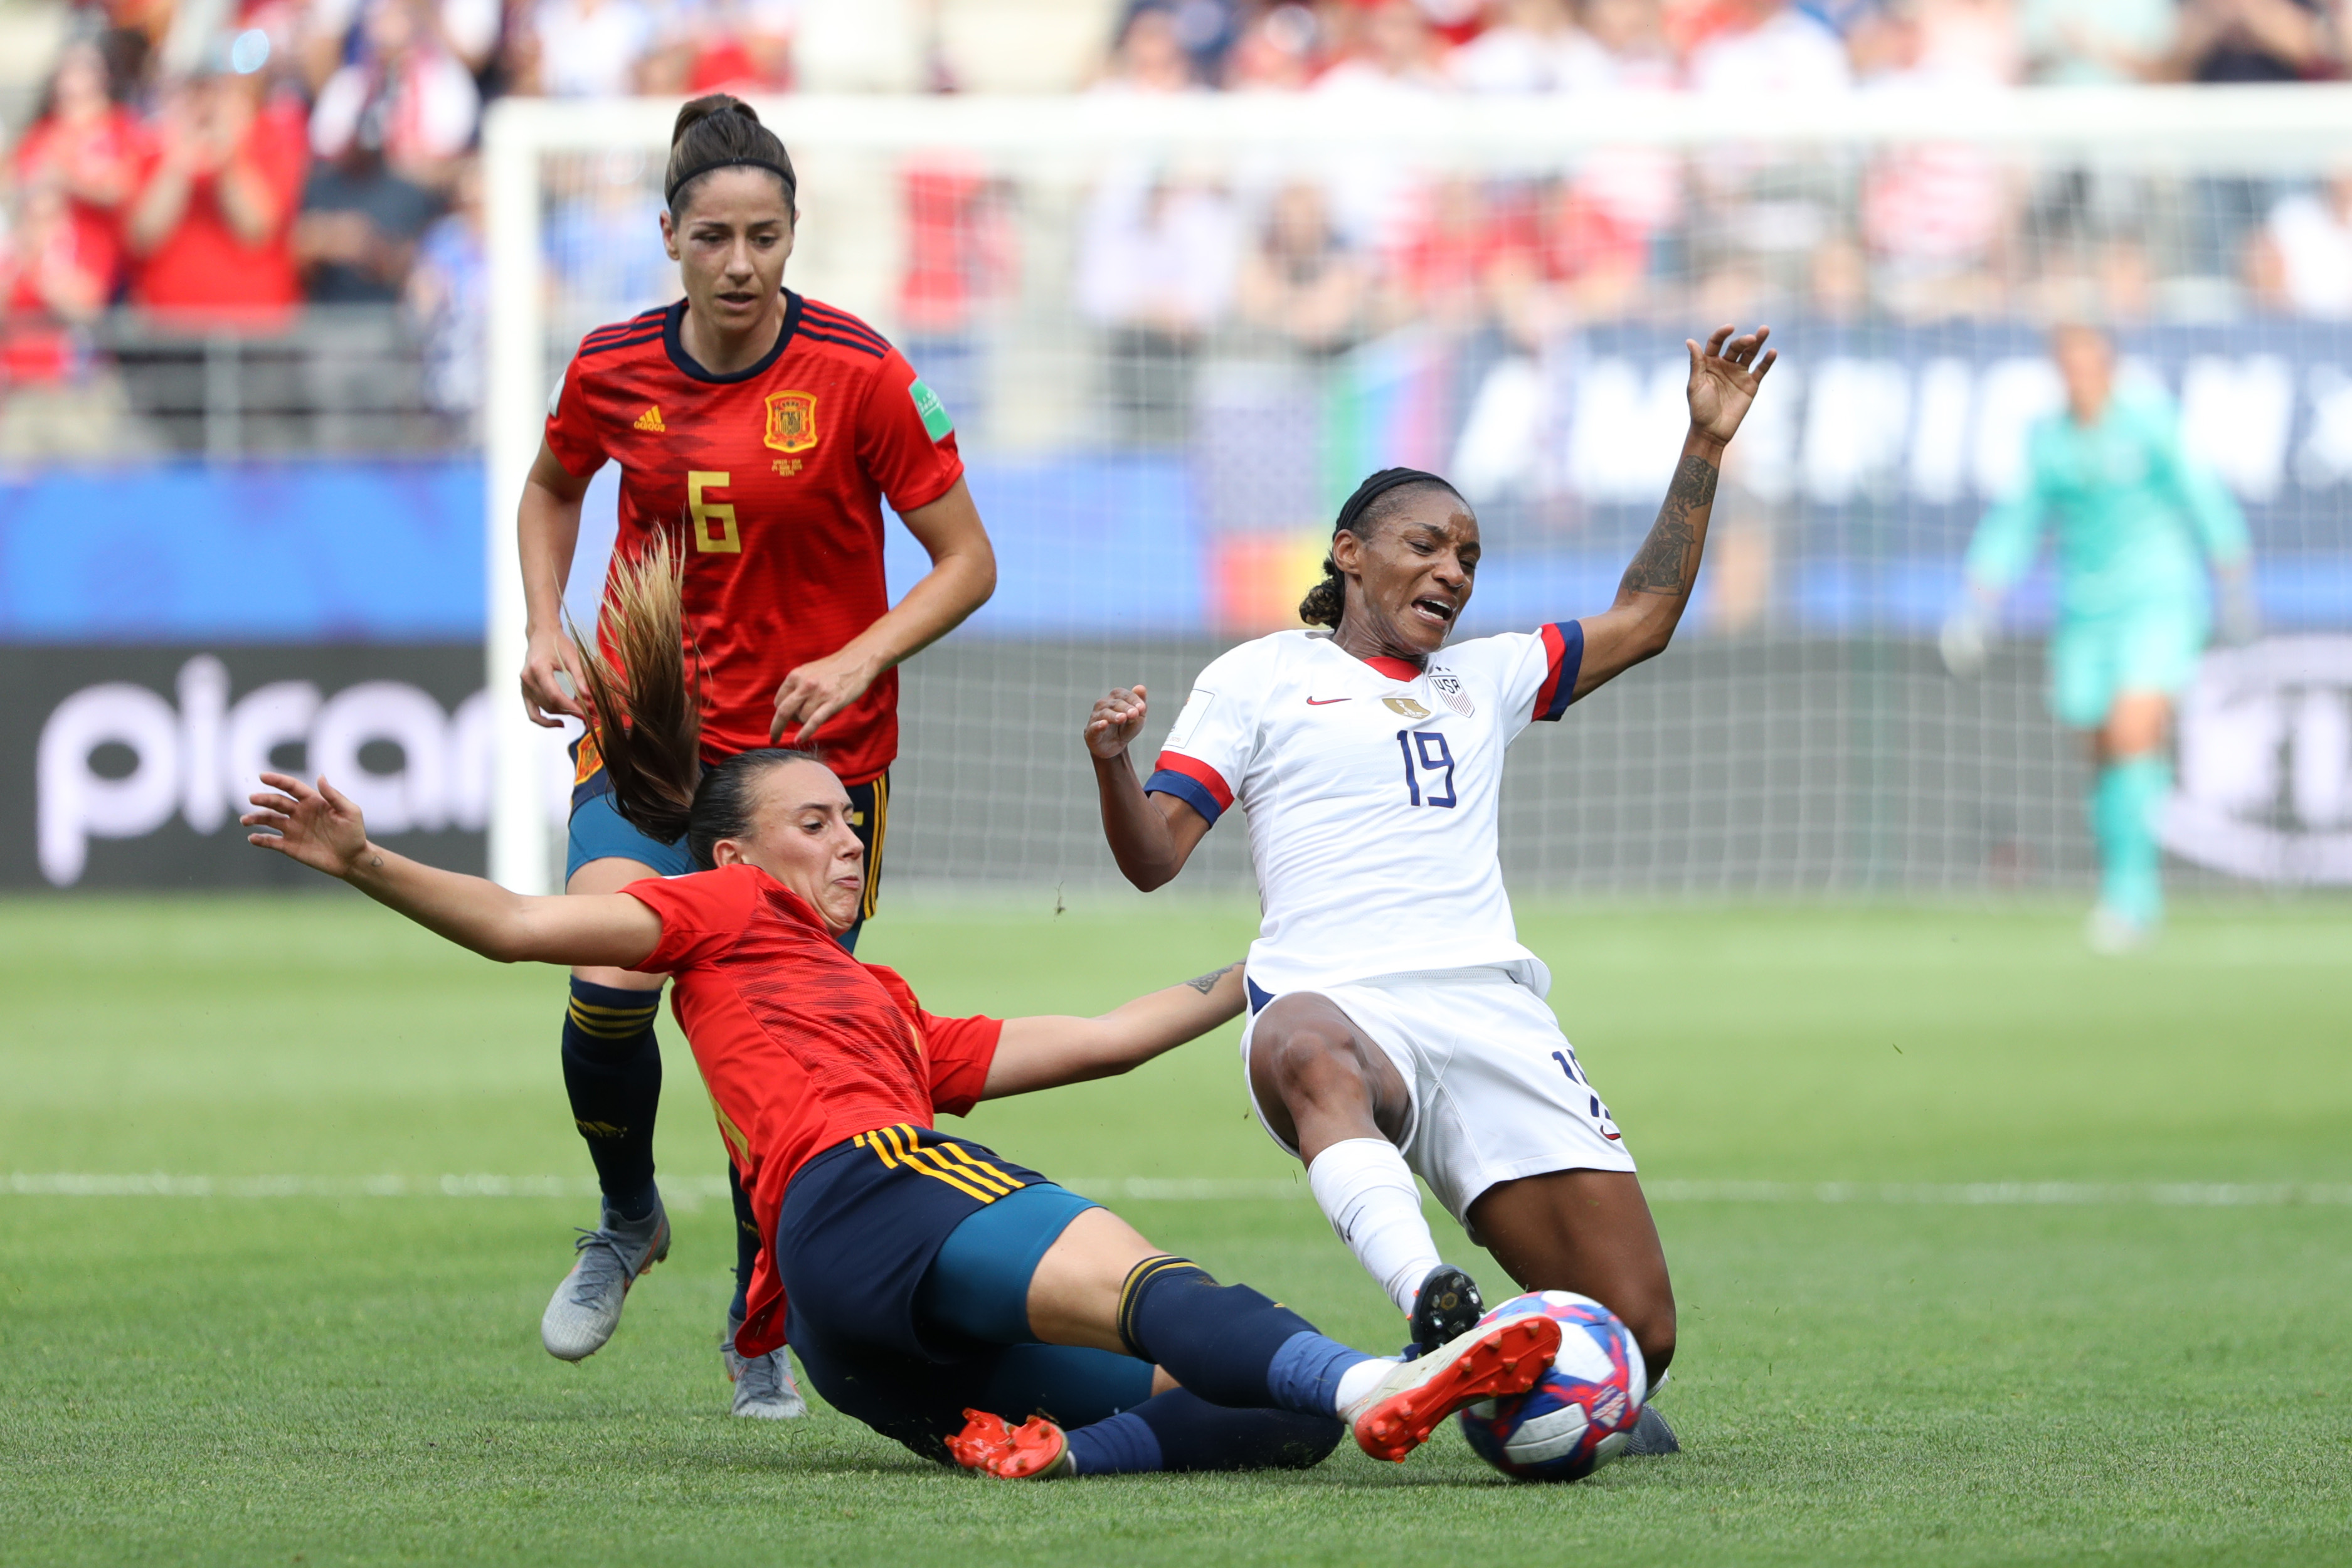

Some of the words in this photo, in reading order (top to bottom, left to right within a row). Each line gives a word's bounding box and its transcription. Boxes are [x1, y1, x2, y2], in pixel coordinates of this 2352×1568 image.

[688, 470, 741, 553] 6
[1433, 679, 1461, 694] USA
[1396, 729, 1457, 809] 19
